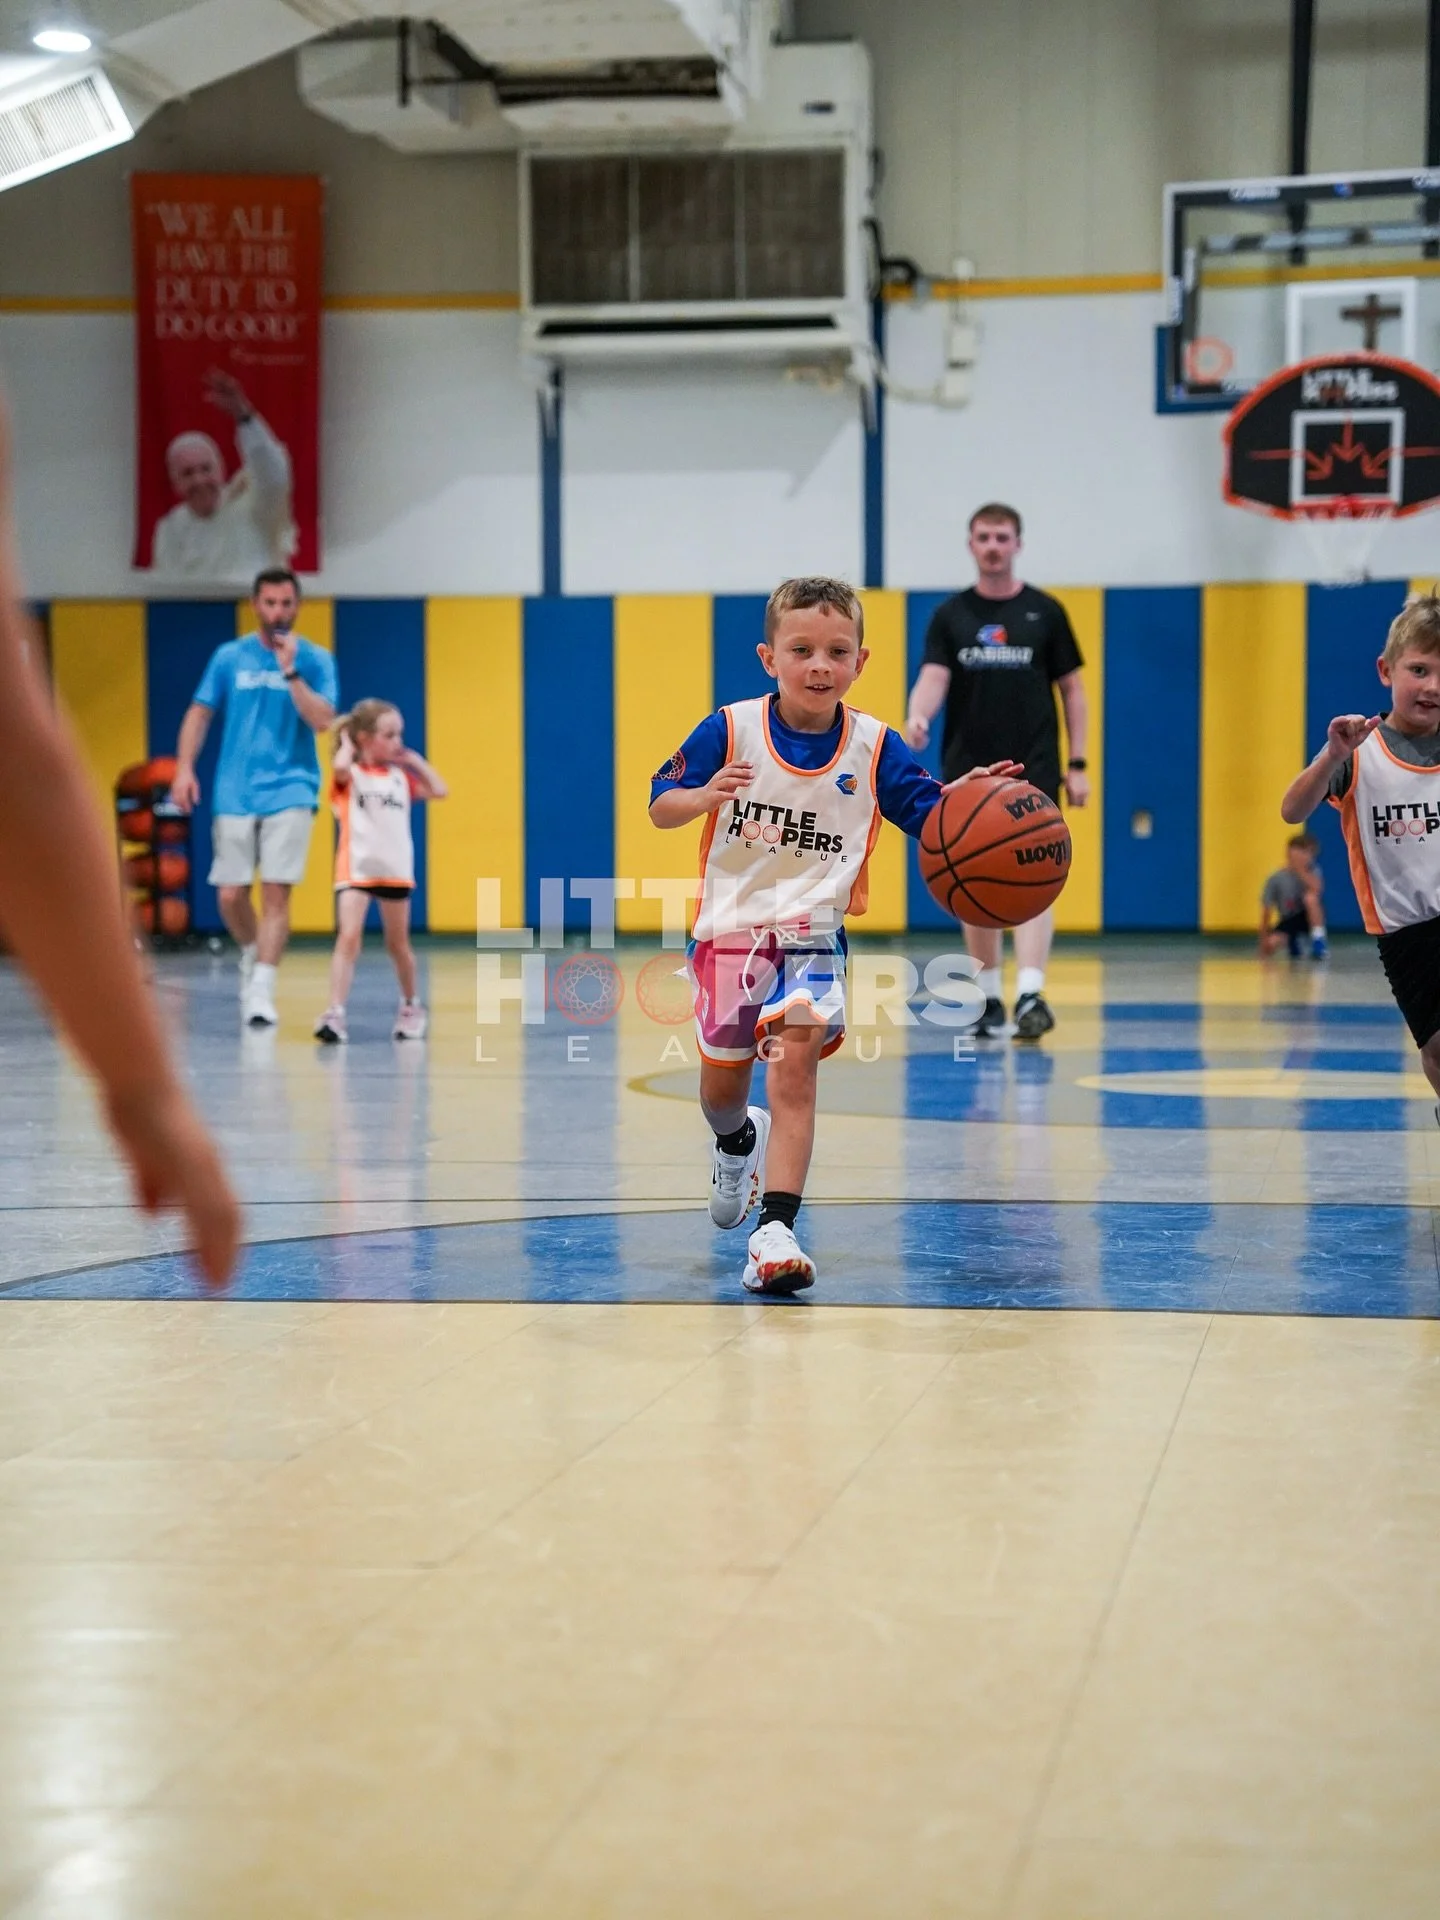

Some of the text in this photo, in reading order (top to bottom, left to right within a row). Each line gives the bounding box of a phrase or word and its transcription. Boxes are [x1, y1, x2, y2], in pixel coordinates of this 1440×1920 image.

[225, 204, 296, 240] ALL
[155, 275, 297, 309] DUTY TO
[155, 310, 202, 340] DO
[733, 798, 817, 831] LITTLE
[1372, 801, 1440, 822] LITTL
[728, 816, 843, 854] HOOPERS
[1015, 840, 1069, 867] ilson
